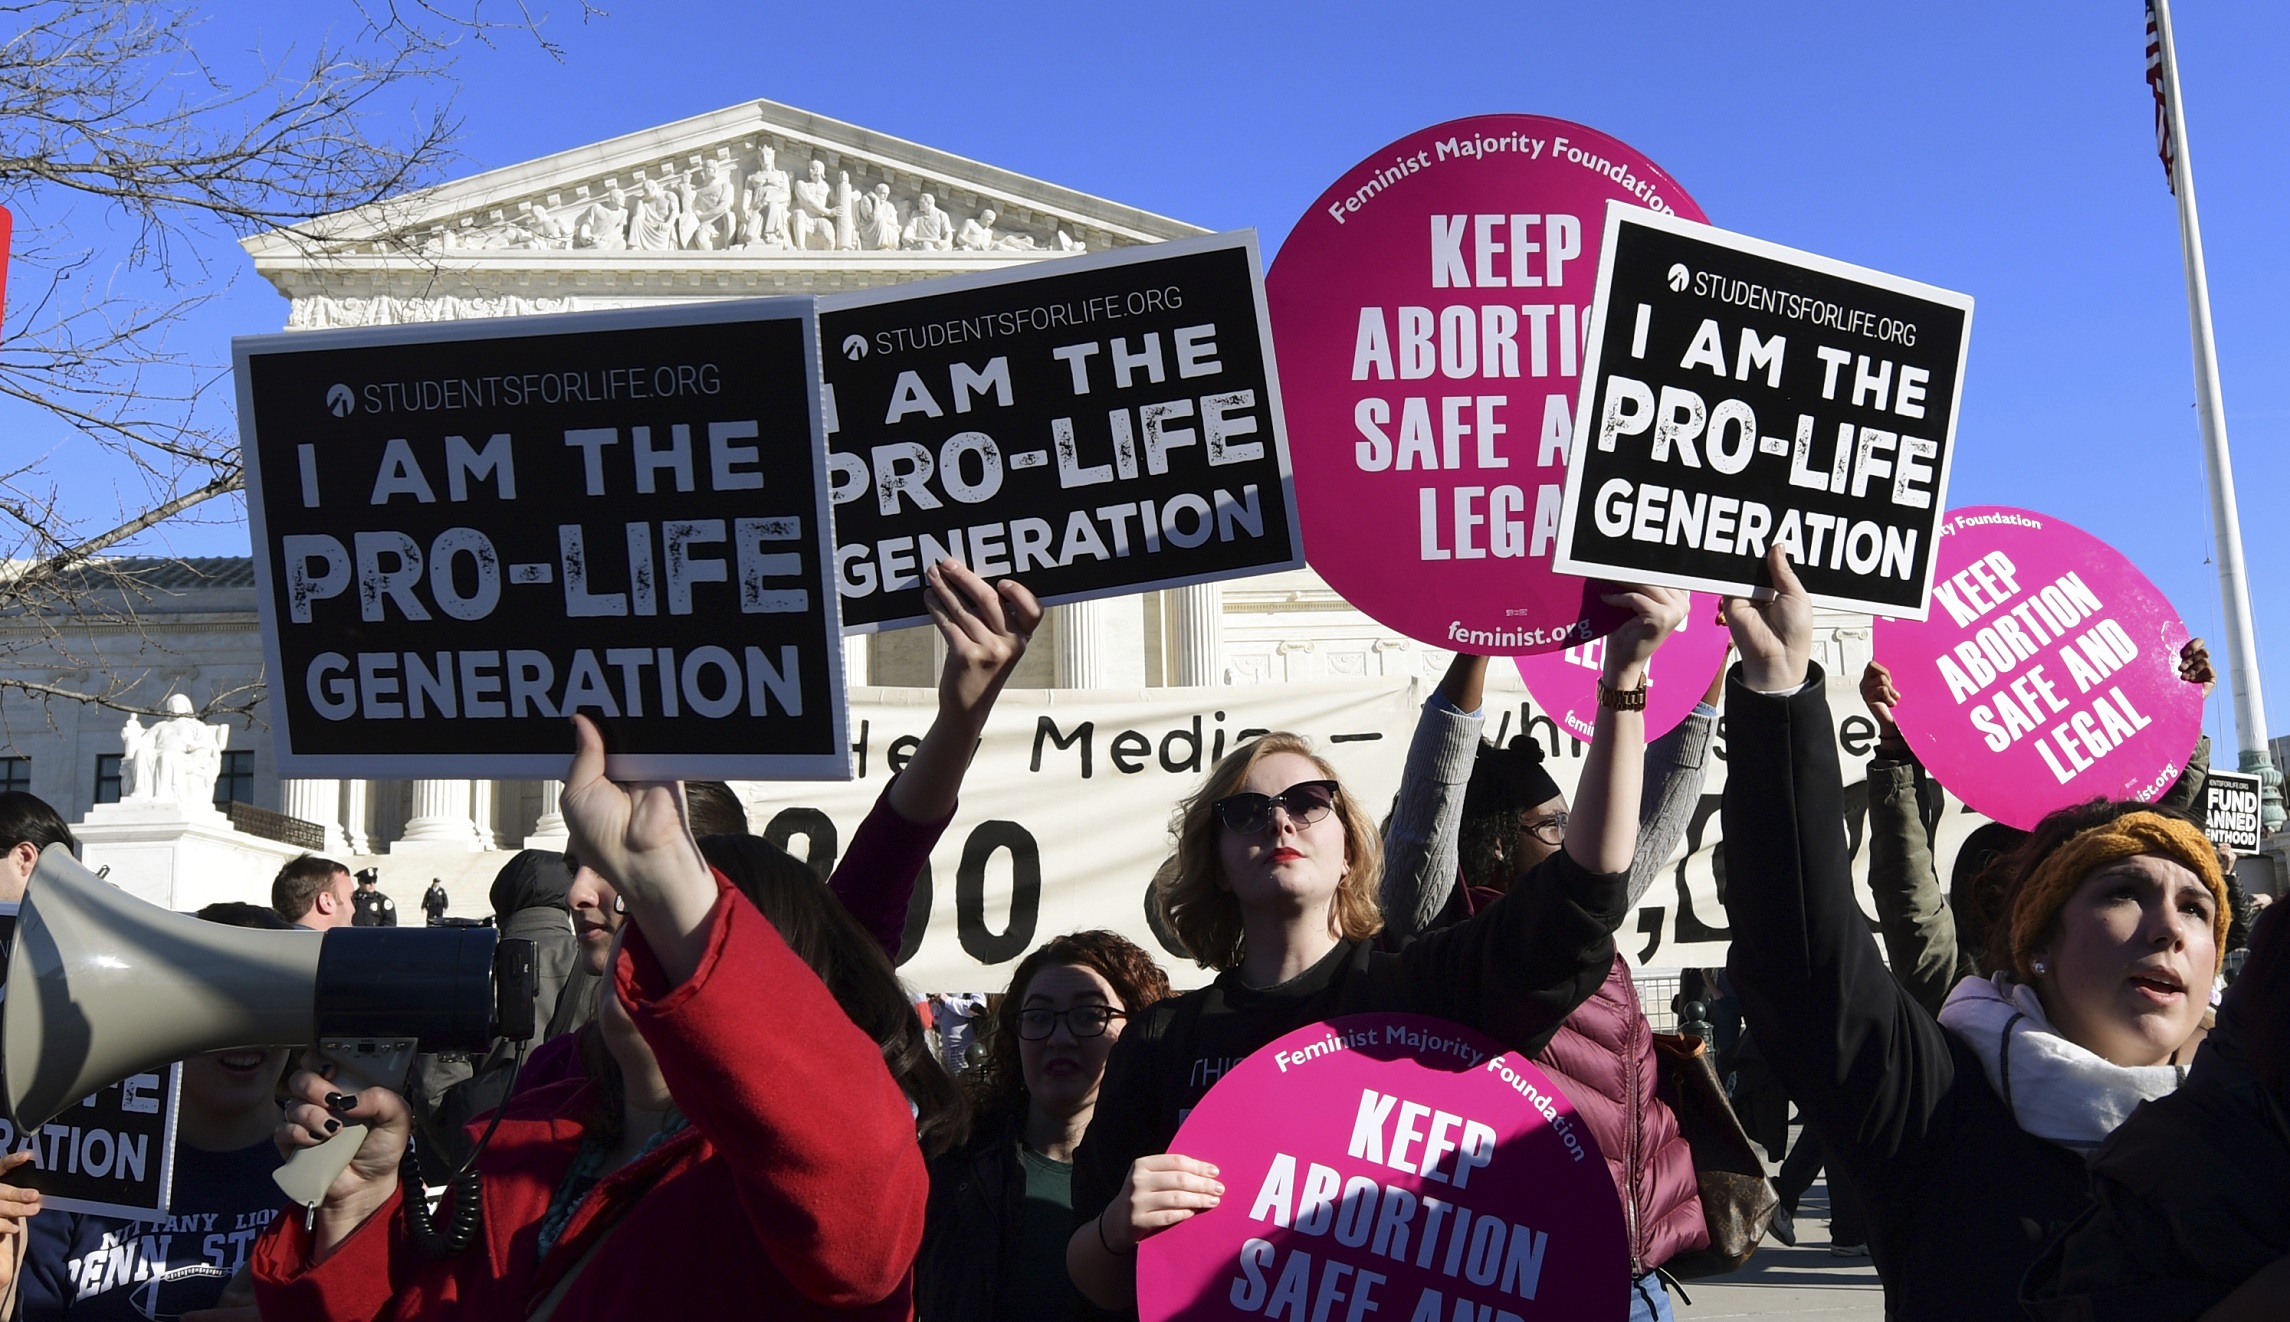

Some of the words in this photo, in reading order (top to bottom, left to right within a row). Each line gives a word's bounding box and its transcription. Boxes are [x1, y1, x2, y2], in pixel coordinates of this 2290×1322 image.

[1328, 149, 1432, 225] Feminist
[1435, 131, 1547, 163] Majority
[1430, 213, 1582, 289] KEEP
[876, 286, 1184, 356] STUDENTSFORLIFE.ORG
[1351, 304, 1592, 381] ABORTI
[1693, 270, 1917, 347] STUDENTSFORLIFE.ORG
[363, 363, 721, 414] STUDENTSFORLIFE.ORG
[885, 356, 1014, 424] AM
[1052, 323, 1223, 396] THE
[1630, 302, 1652, 359] I
[1679, 318, 1787, 389] AM
[1816, 345, 1930, 419] THE
[297, 442, 320, 508] I
[370, 433, 516, 506] AM
[564, 420, 764, 496] THE
[1354, 395, 1509, 472] SAFE
[1598, 374, 1938, 509] PRO-LIFE
[837, 484, 1265, 598] GENERATION
[1594, 477, 1918, 581] GENERATION
[1955, 512, 2042, 530] Foundation
[282, 515, 808, 624] PRO-LIFE
[1932, 550, 2022, 629] KEEP
[1447, 619, 1594, 649] feminist.org
[1935, 570, 2104, 705] ABORTION
[306, 644, 803, 721] GENERATION
[1969, 664, 2070, 753] SAFE
[2058, 617, 2140, 694] AND
[1030, 710, 1271, 779] Medi
[2034, 686, 2152, 786] LEGAL
[2207, 788, 2257, 813] FUND
[1273, 1026, 1379, 1074] Feminist
[1385, 1026, 1485, 1068] Majority
[1487, 1055, 1586, 1163] Foundation
[1347, 1088, 1497, 1190] KEEP
[1248, 1152, 1549, 1301] ABORTION
[1229, 1237, 1388, 1322] SAFE
